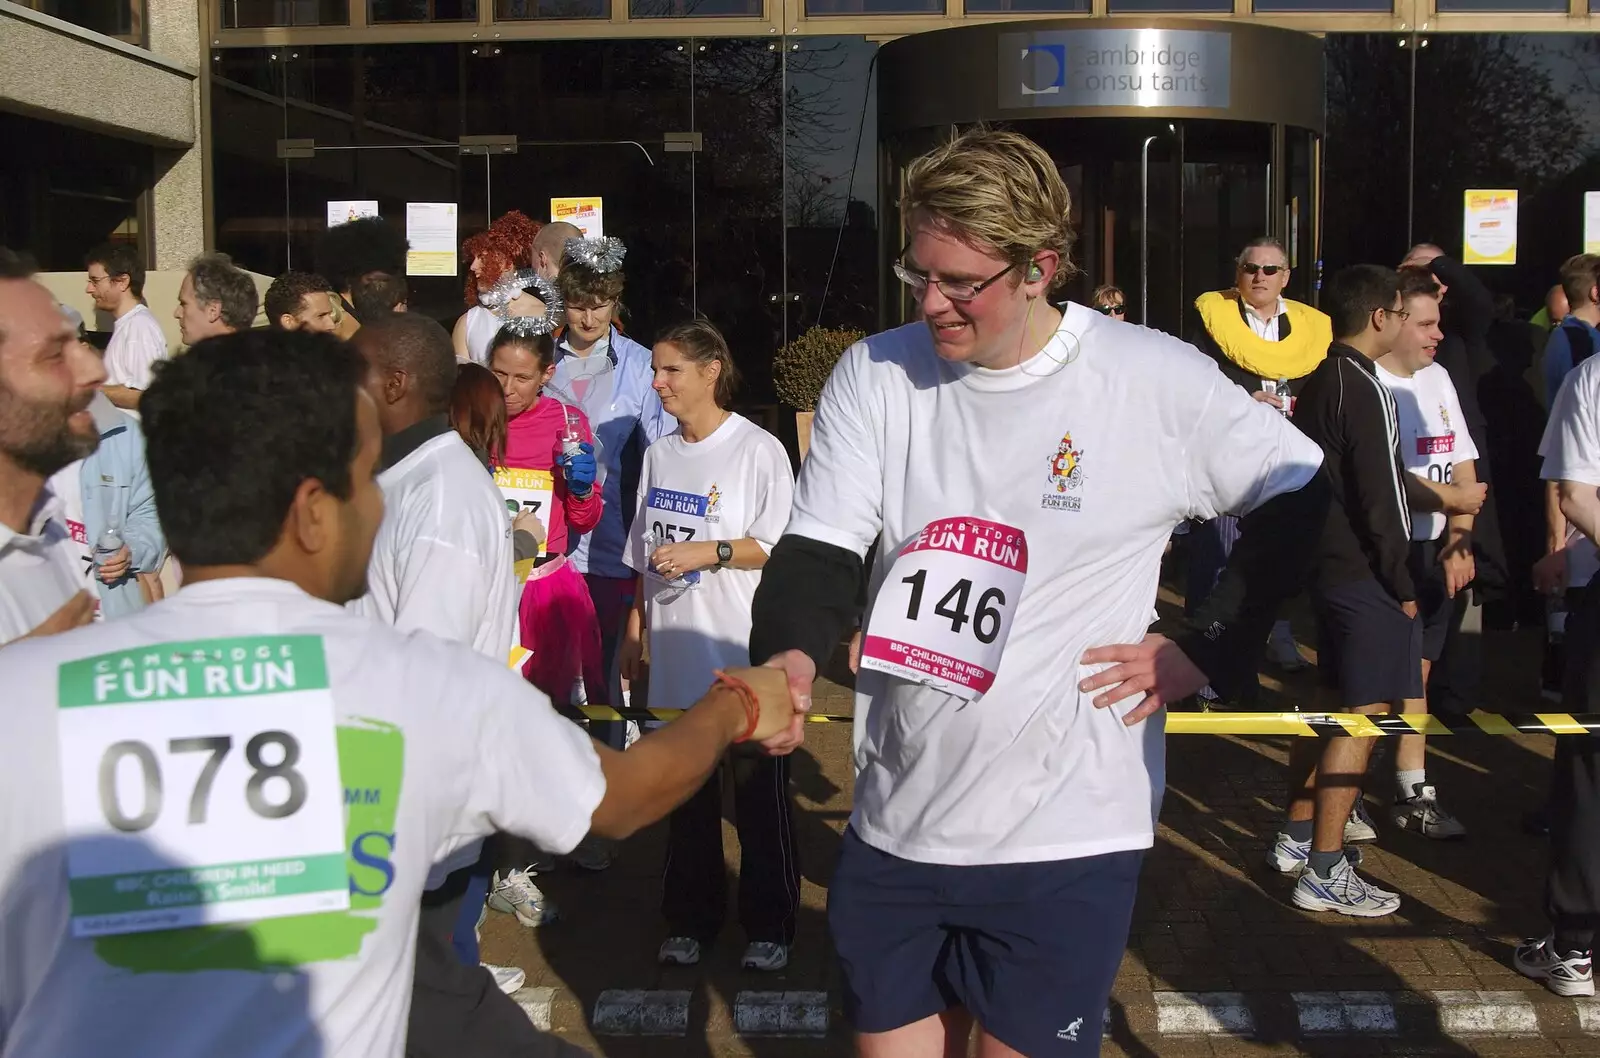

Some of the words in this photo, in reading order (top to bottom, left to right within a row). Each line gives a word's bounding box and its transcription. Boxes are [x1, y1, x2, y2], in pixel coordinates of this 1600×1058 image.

[1071, 44, 1200, 72] ambridge
[1071, 70, 1209, 92] onsutants
[516, 477, 544, 488] RUN
[654, 497, 673, 510] FUN
[675, 501, 698, 515] RUN
[656, 491, 699, 504] CAMBRIDGE
[1042, 494, 1081, 502] CAMBRIDGE
[1042, 499, 1060, 507] FUN
[1062, 501, 1081, 509] RUN
[920, 522, 1022, 547] CAMBRIDGE
[914, 532, 966, 550] FUN
[973, 537, 1020, 567] RUN
[901, 569, 1006, 645] 146
[95, 645, 293, 674] CAMBRIDGE
[890, 642, 909, 654] BBC
[911, 648, 953, 668] CHILDREN
[955, 660, 965, 671] IN
[966, 665, 985, 678] NEED
[905, 656, 931, 671] Raise
[932, 666, 939, 674] a
[941, 667, 971, 684] Smile!
[94, 667, 188, 701] FUN
[204, 661, 296, 695] RUN
[98, 729, 308, 832] 078
[241, 864, 258, 878] IN
[263, 860, 306, 876] NEED
